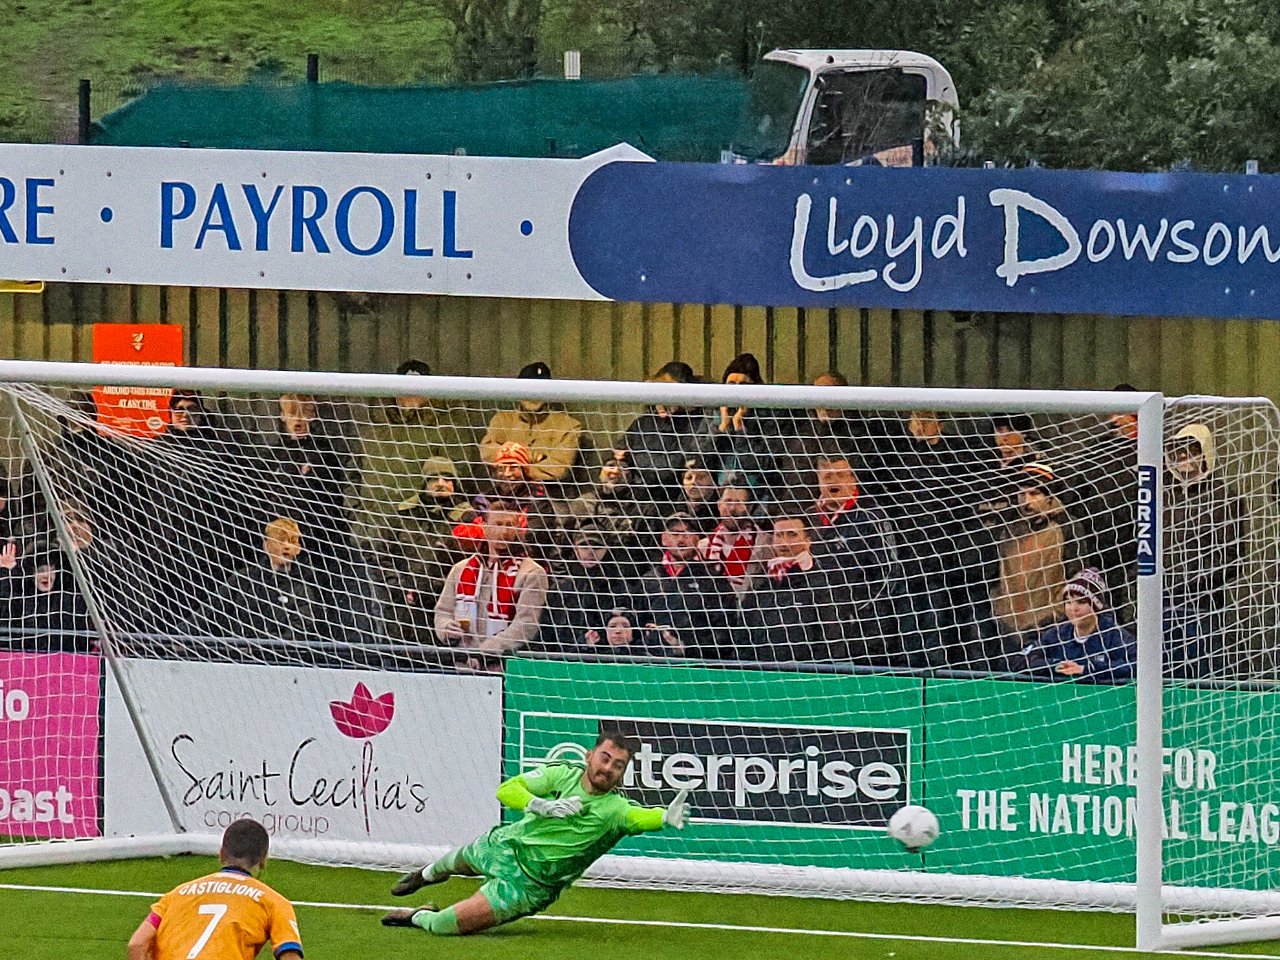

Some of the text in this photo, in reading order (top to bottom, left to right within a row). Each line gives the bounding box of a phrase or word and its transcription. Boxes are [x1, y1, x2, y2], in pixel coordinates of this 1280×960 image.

[160, 181, 474, 259] PAYROLL
[790, 187, 1280, 292] Lloyd Dowson
[1137, 471, 1152, 556] FORZA
[171, 733, 429, 836] Saint Cecilia's
[957, 788, 1018, 832] THE
[266, 812, 330, 838] group
[186, 904, 228, 960] 7
